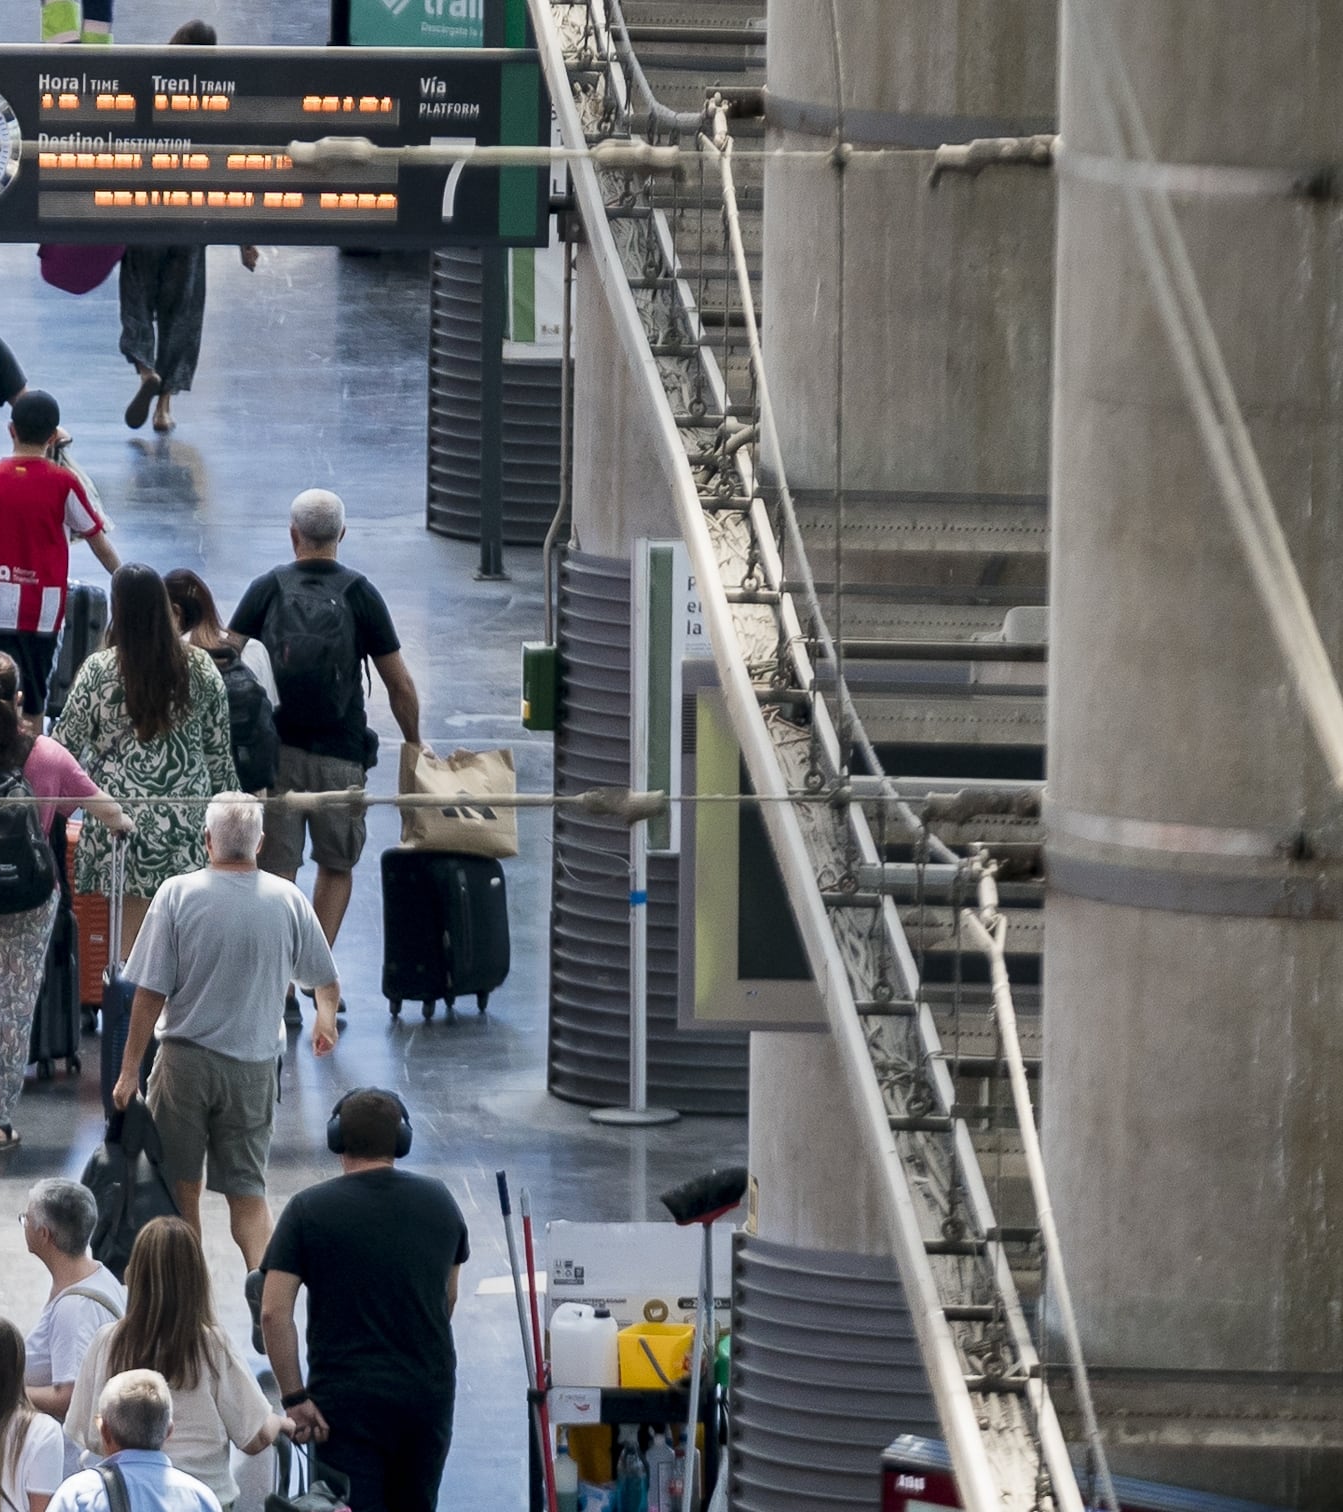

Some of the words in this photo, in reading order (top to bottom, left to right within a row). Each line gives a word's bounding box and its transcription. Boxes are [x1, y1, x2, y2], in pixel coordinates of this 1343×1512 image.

[38, 74, 79, 90] Hora
[90, 79, 120, 91] TIME
[152, 75, 189, 91] Tren
[200, 81, 236, 92] TRAIN
[420, 76, 447, 94] Vía
[419, 102, 480, 115] PLATFORM
[38, 133, 104, 149] Destino
[115, 137, 192, 150] DESTINATION
[430, 136, 476, 217] 7
